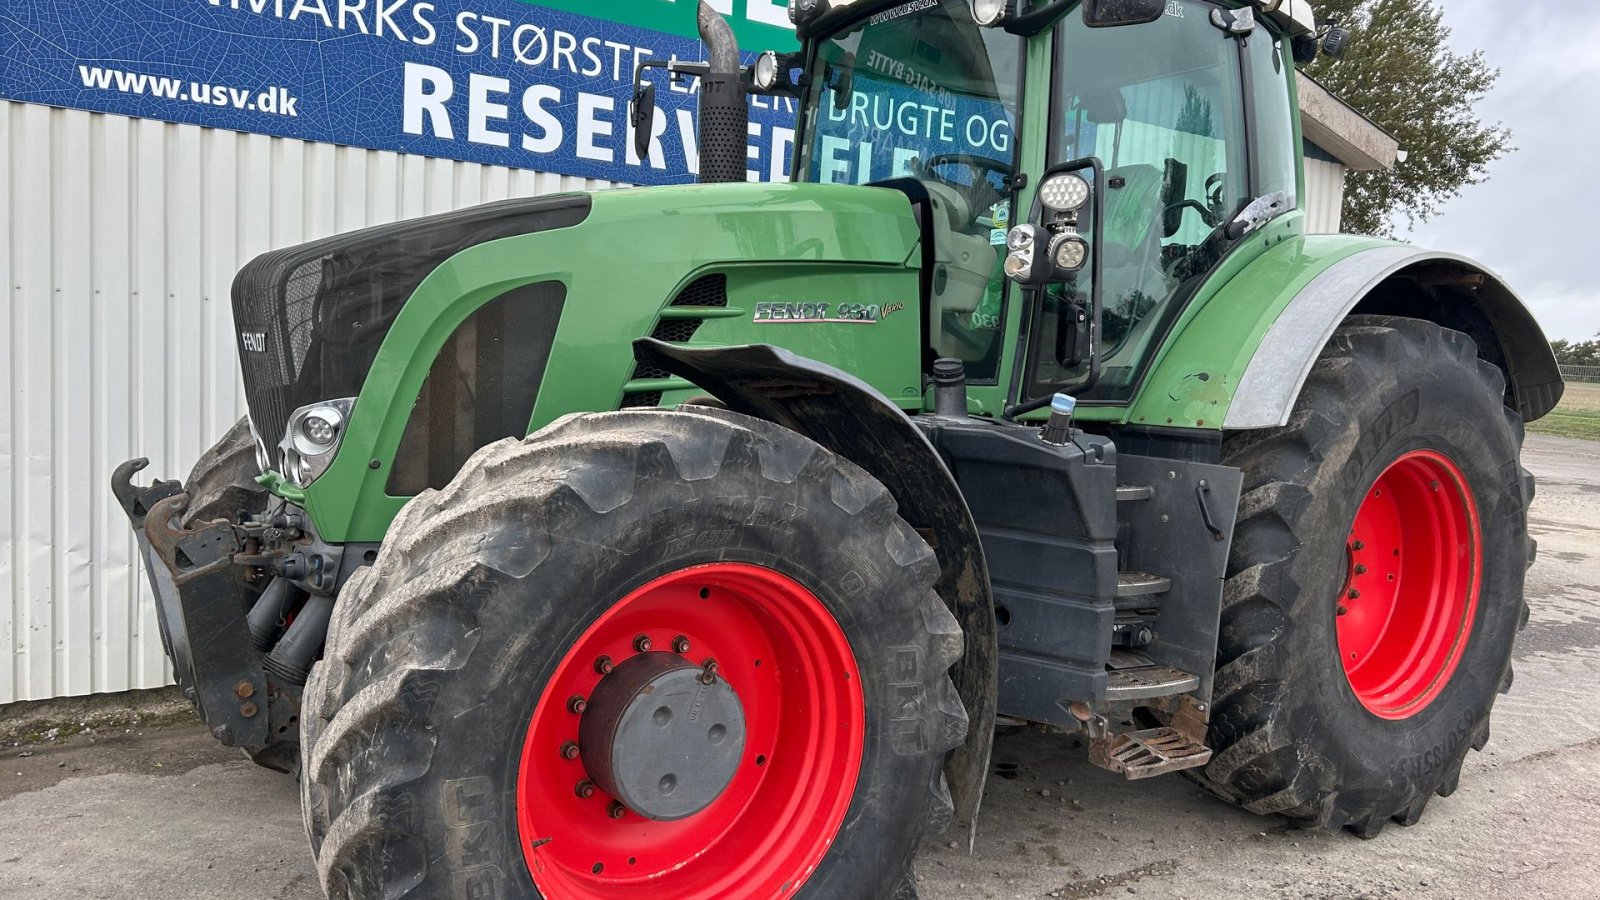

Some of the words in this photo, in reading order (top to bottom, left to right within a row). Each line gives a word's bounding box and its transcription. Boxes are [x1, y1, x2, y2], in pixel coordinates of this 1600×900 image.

[78, 65, 298, 117] www.usv.dk
[966, 114, 1010, 152] OG
[753, 302, 830, 321] FENDT
[837, 302, 880, 321] 930
[241, 332, 266, 352] FENDT
